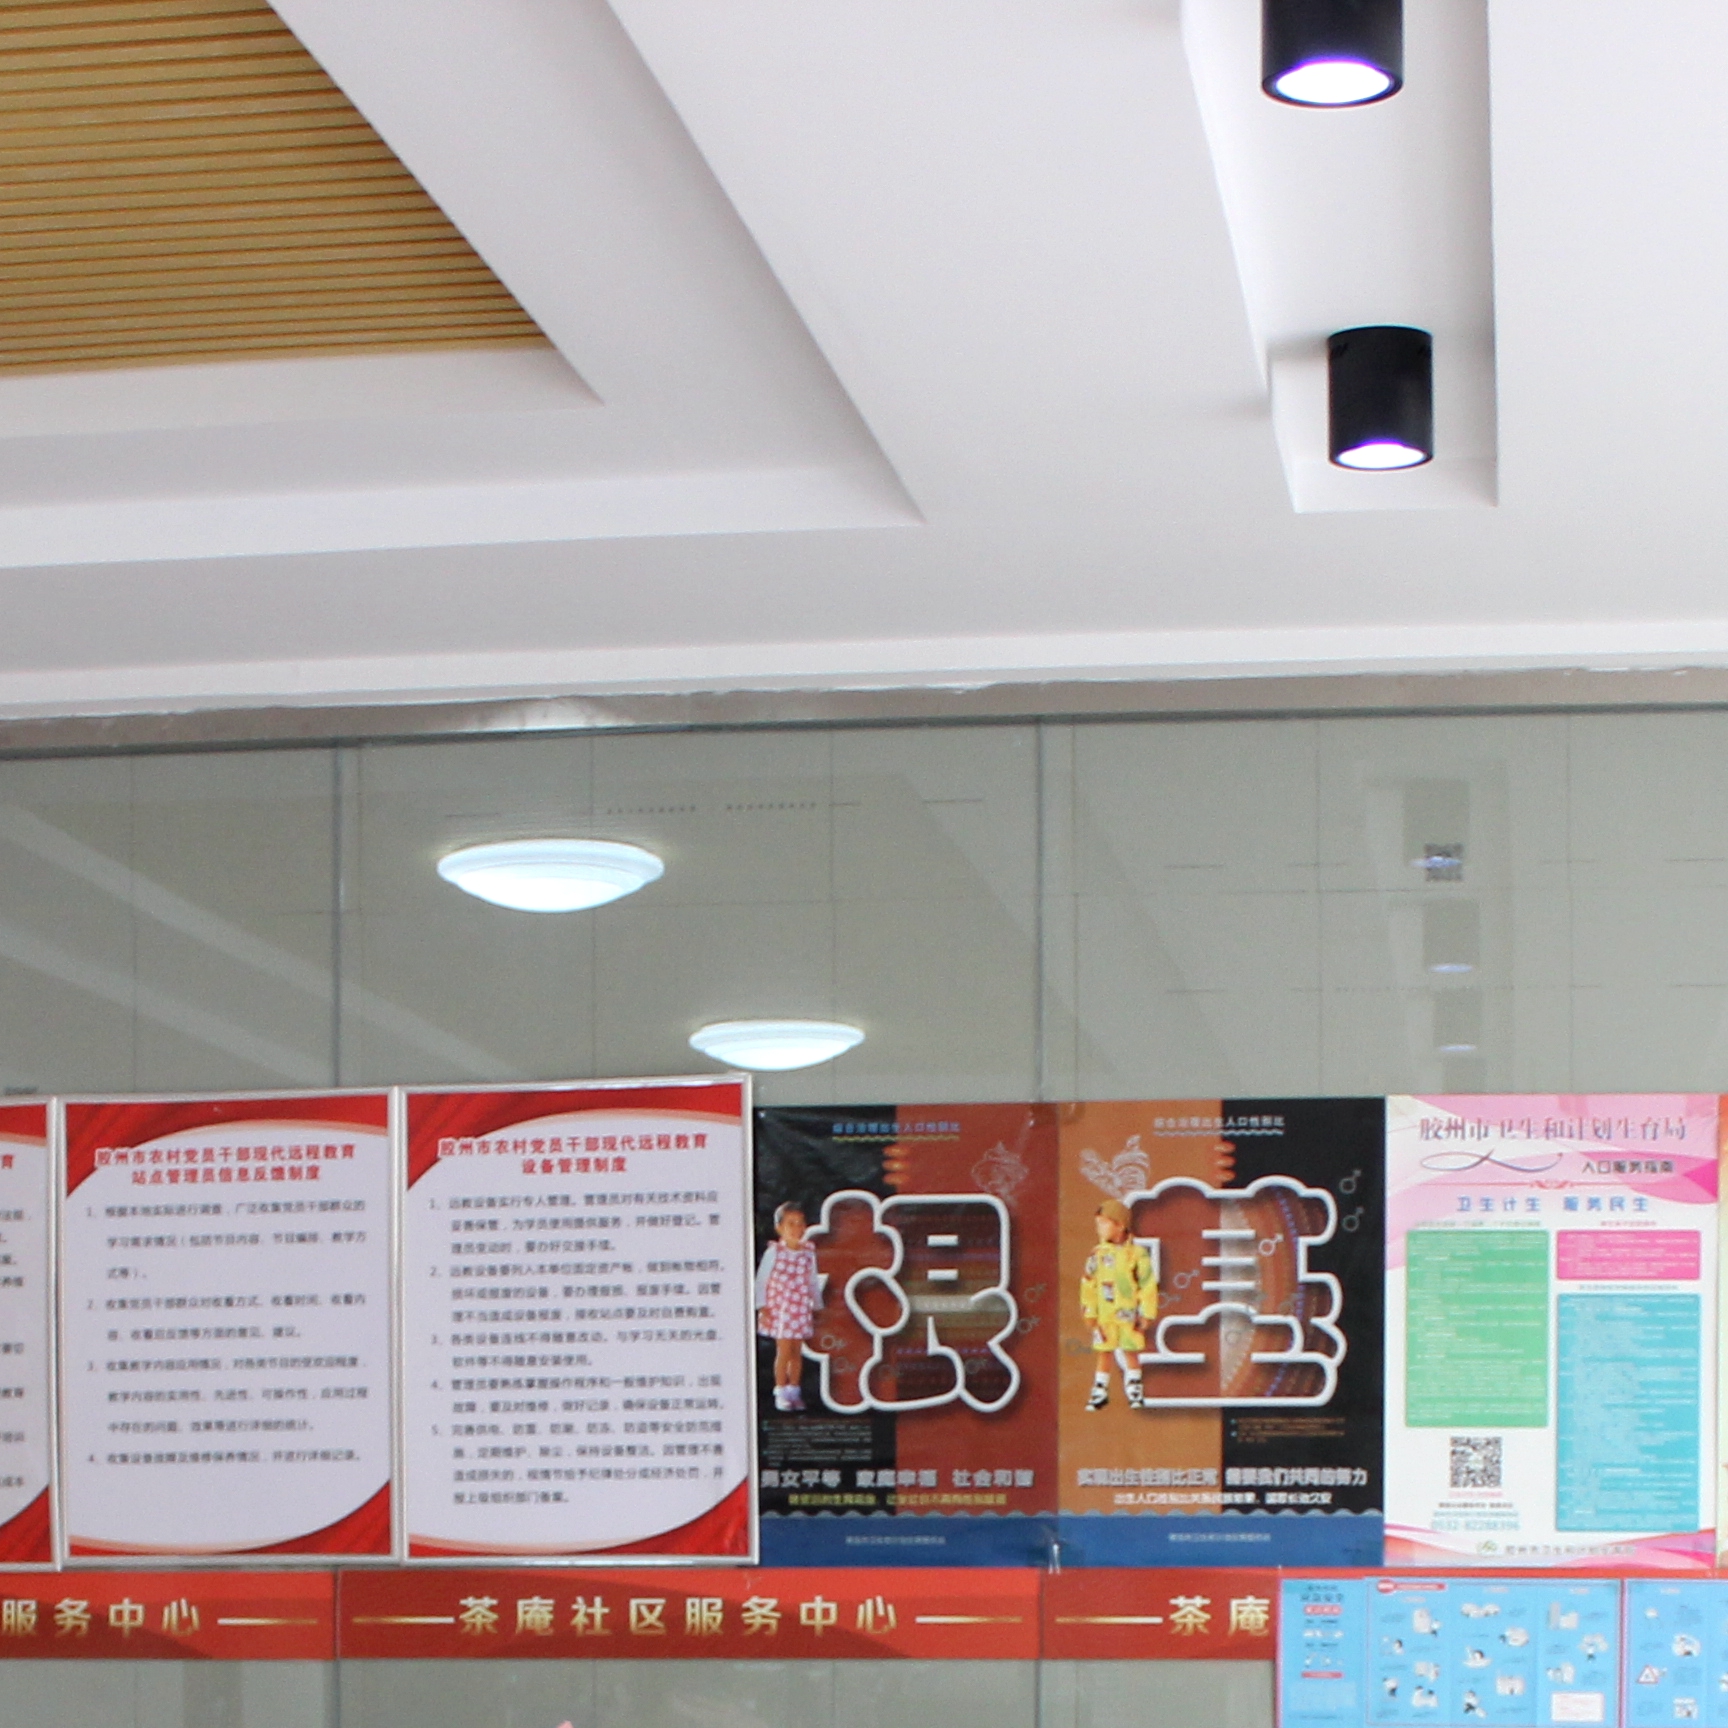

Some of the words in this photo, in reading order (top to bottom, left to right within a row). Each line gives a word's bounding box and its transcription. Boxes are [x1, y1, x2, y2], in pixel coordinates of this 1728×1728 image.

[1420, 1116, 1686, 1142] 胶州市卫生和计划生育局
[95, 1143, 357, 1167] 胶州市农村党员干部现代远程教育
[438, 1133, 709, 1157] 胶州市农村党员干部现代远程教育
[521, 1157, 628, 1175] 设备管理制度
[1582, 1160, 1675, 1174] 人口服务指南
[1457, 1196, 1542, 1212] 卫生计生
[1563, 1196, 1649, 1212] 服务民生
[459, 1595, 898, 1637] 茶庵社区服务中心
[1169, 1594, 1271, 1636] 茶庵
